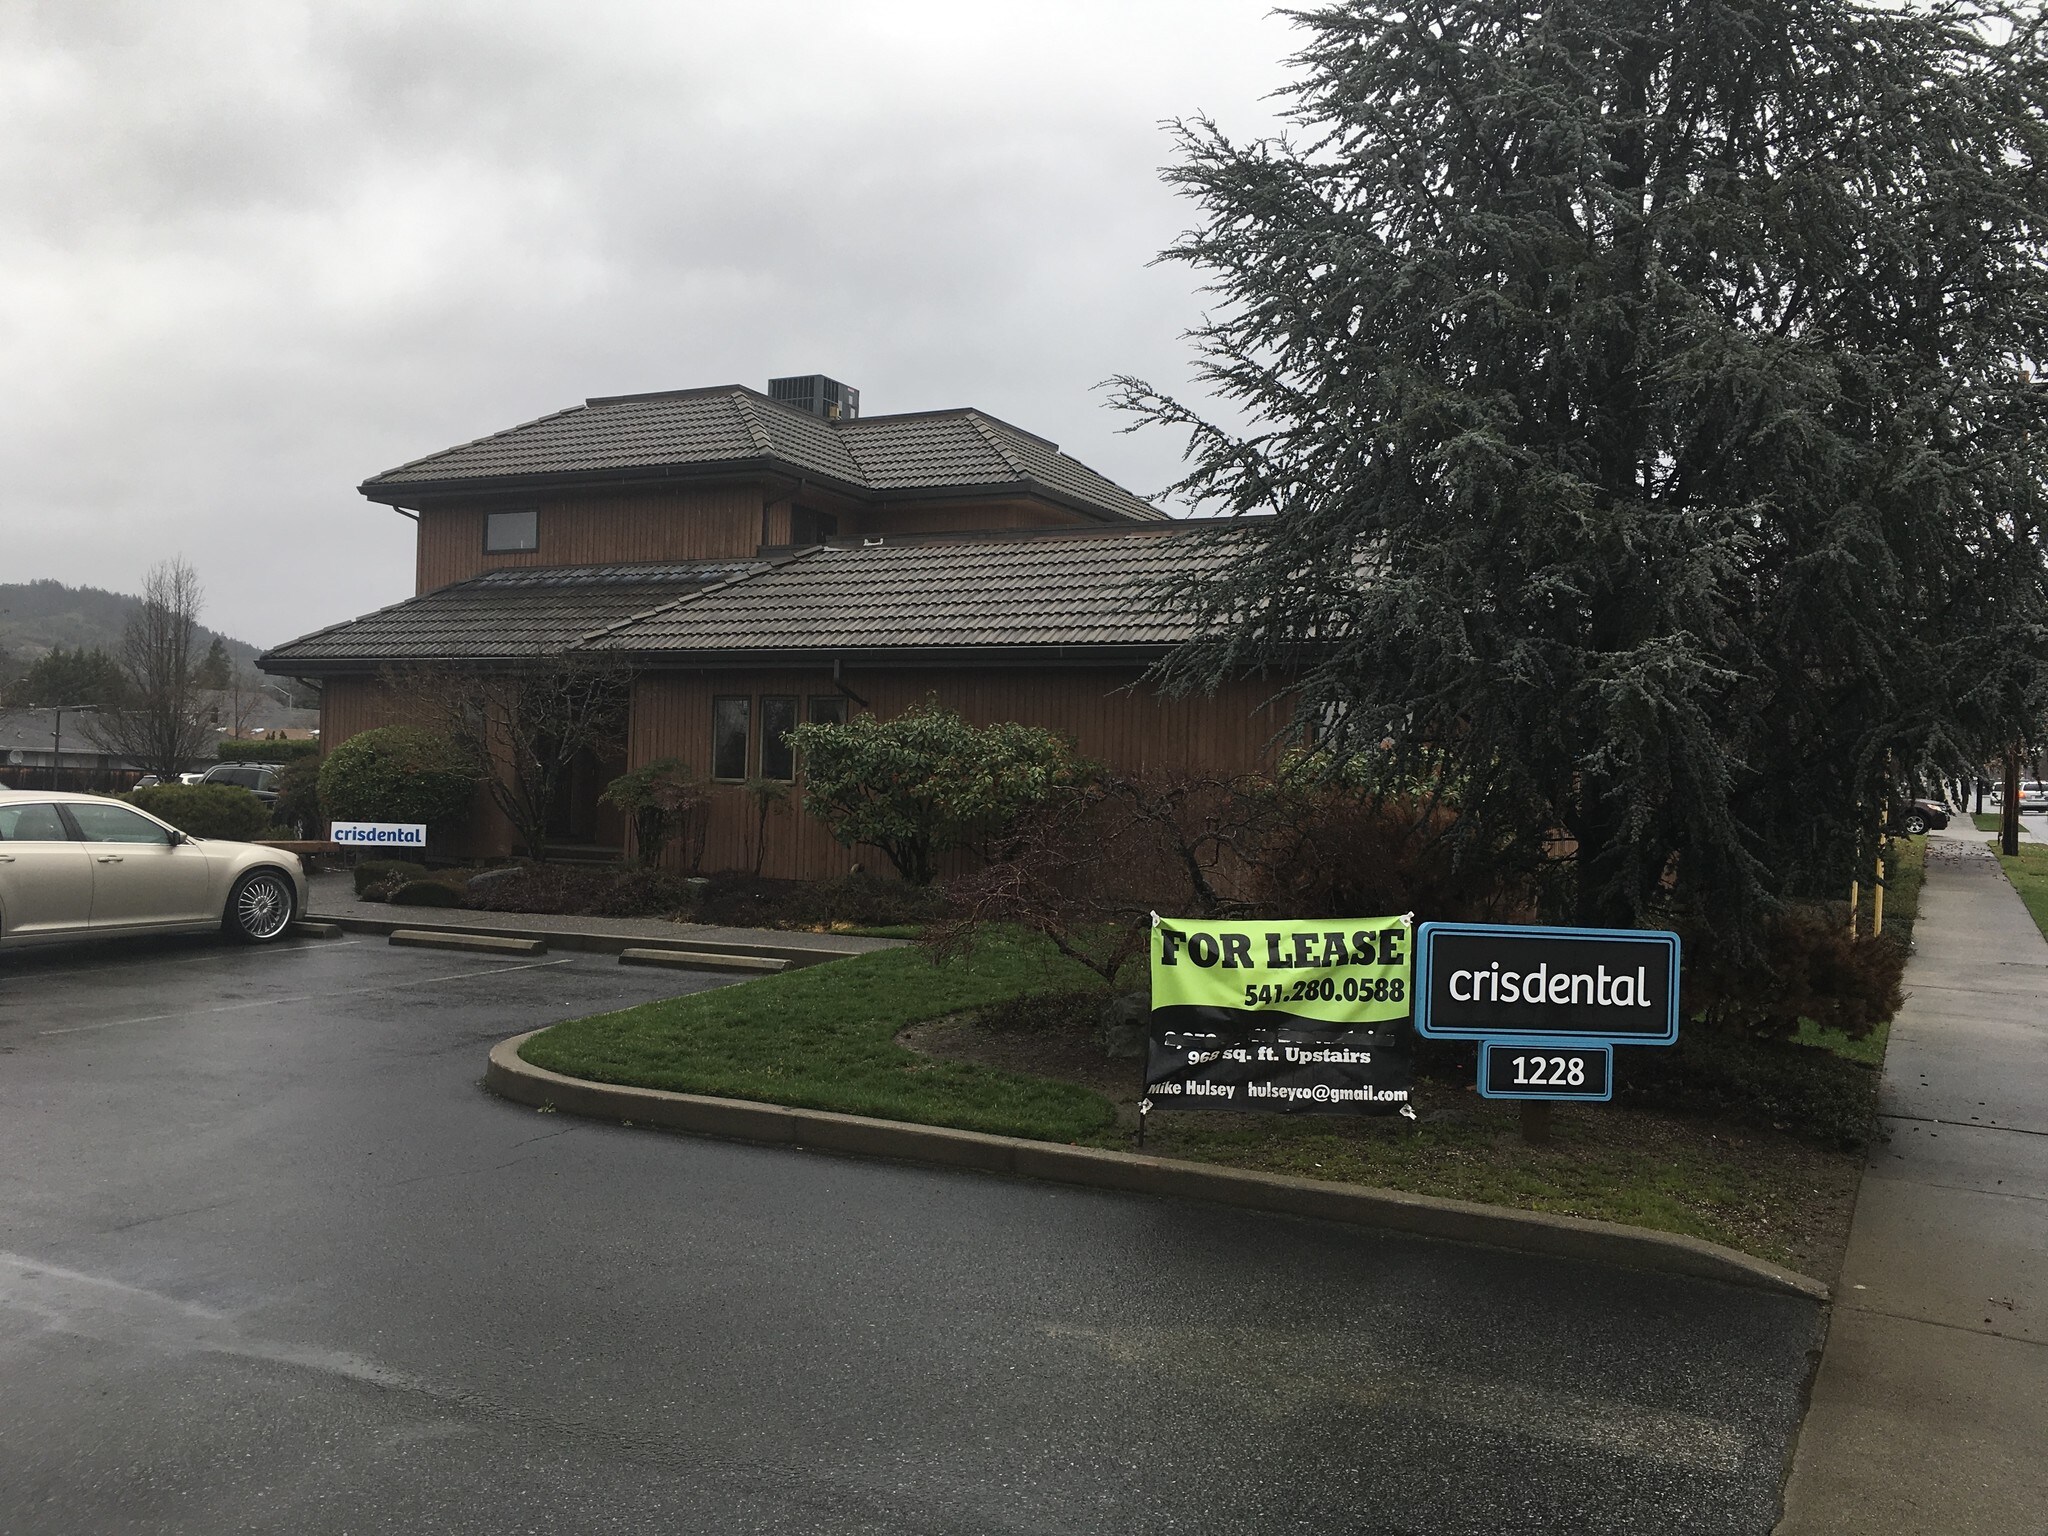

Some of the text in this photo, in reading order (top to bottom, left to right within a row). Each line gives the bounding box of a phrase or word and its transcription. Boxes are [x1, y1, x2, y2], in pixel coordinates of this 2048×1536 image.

[334, 826, 422, 843] crisdental
[1161, 928, 1405, 969] FOR LEASE
[1244, 977, 1405, 1006] 541.280.0588
[1449, 961, 1651, 1007] crisdental
[1187, 1046, 1371, 1065] 968 sq. ft. Upstairs
[1512, 1056, 1585, 1086] 1228
[1147, 1080, 1408, 1103] Mike Hulsey hulseyco@gmail.com
